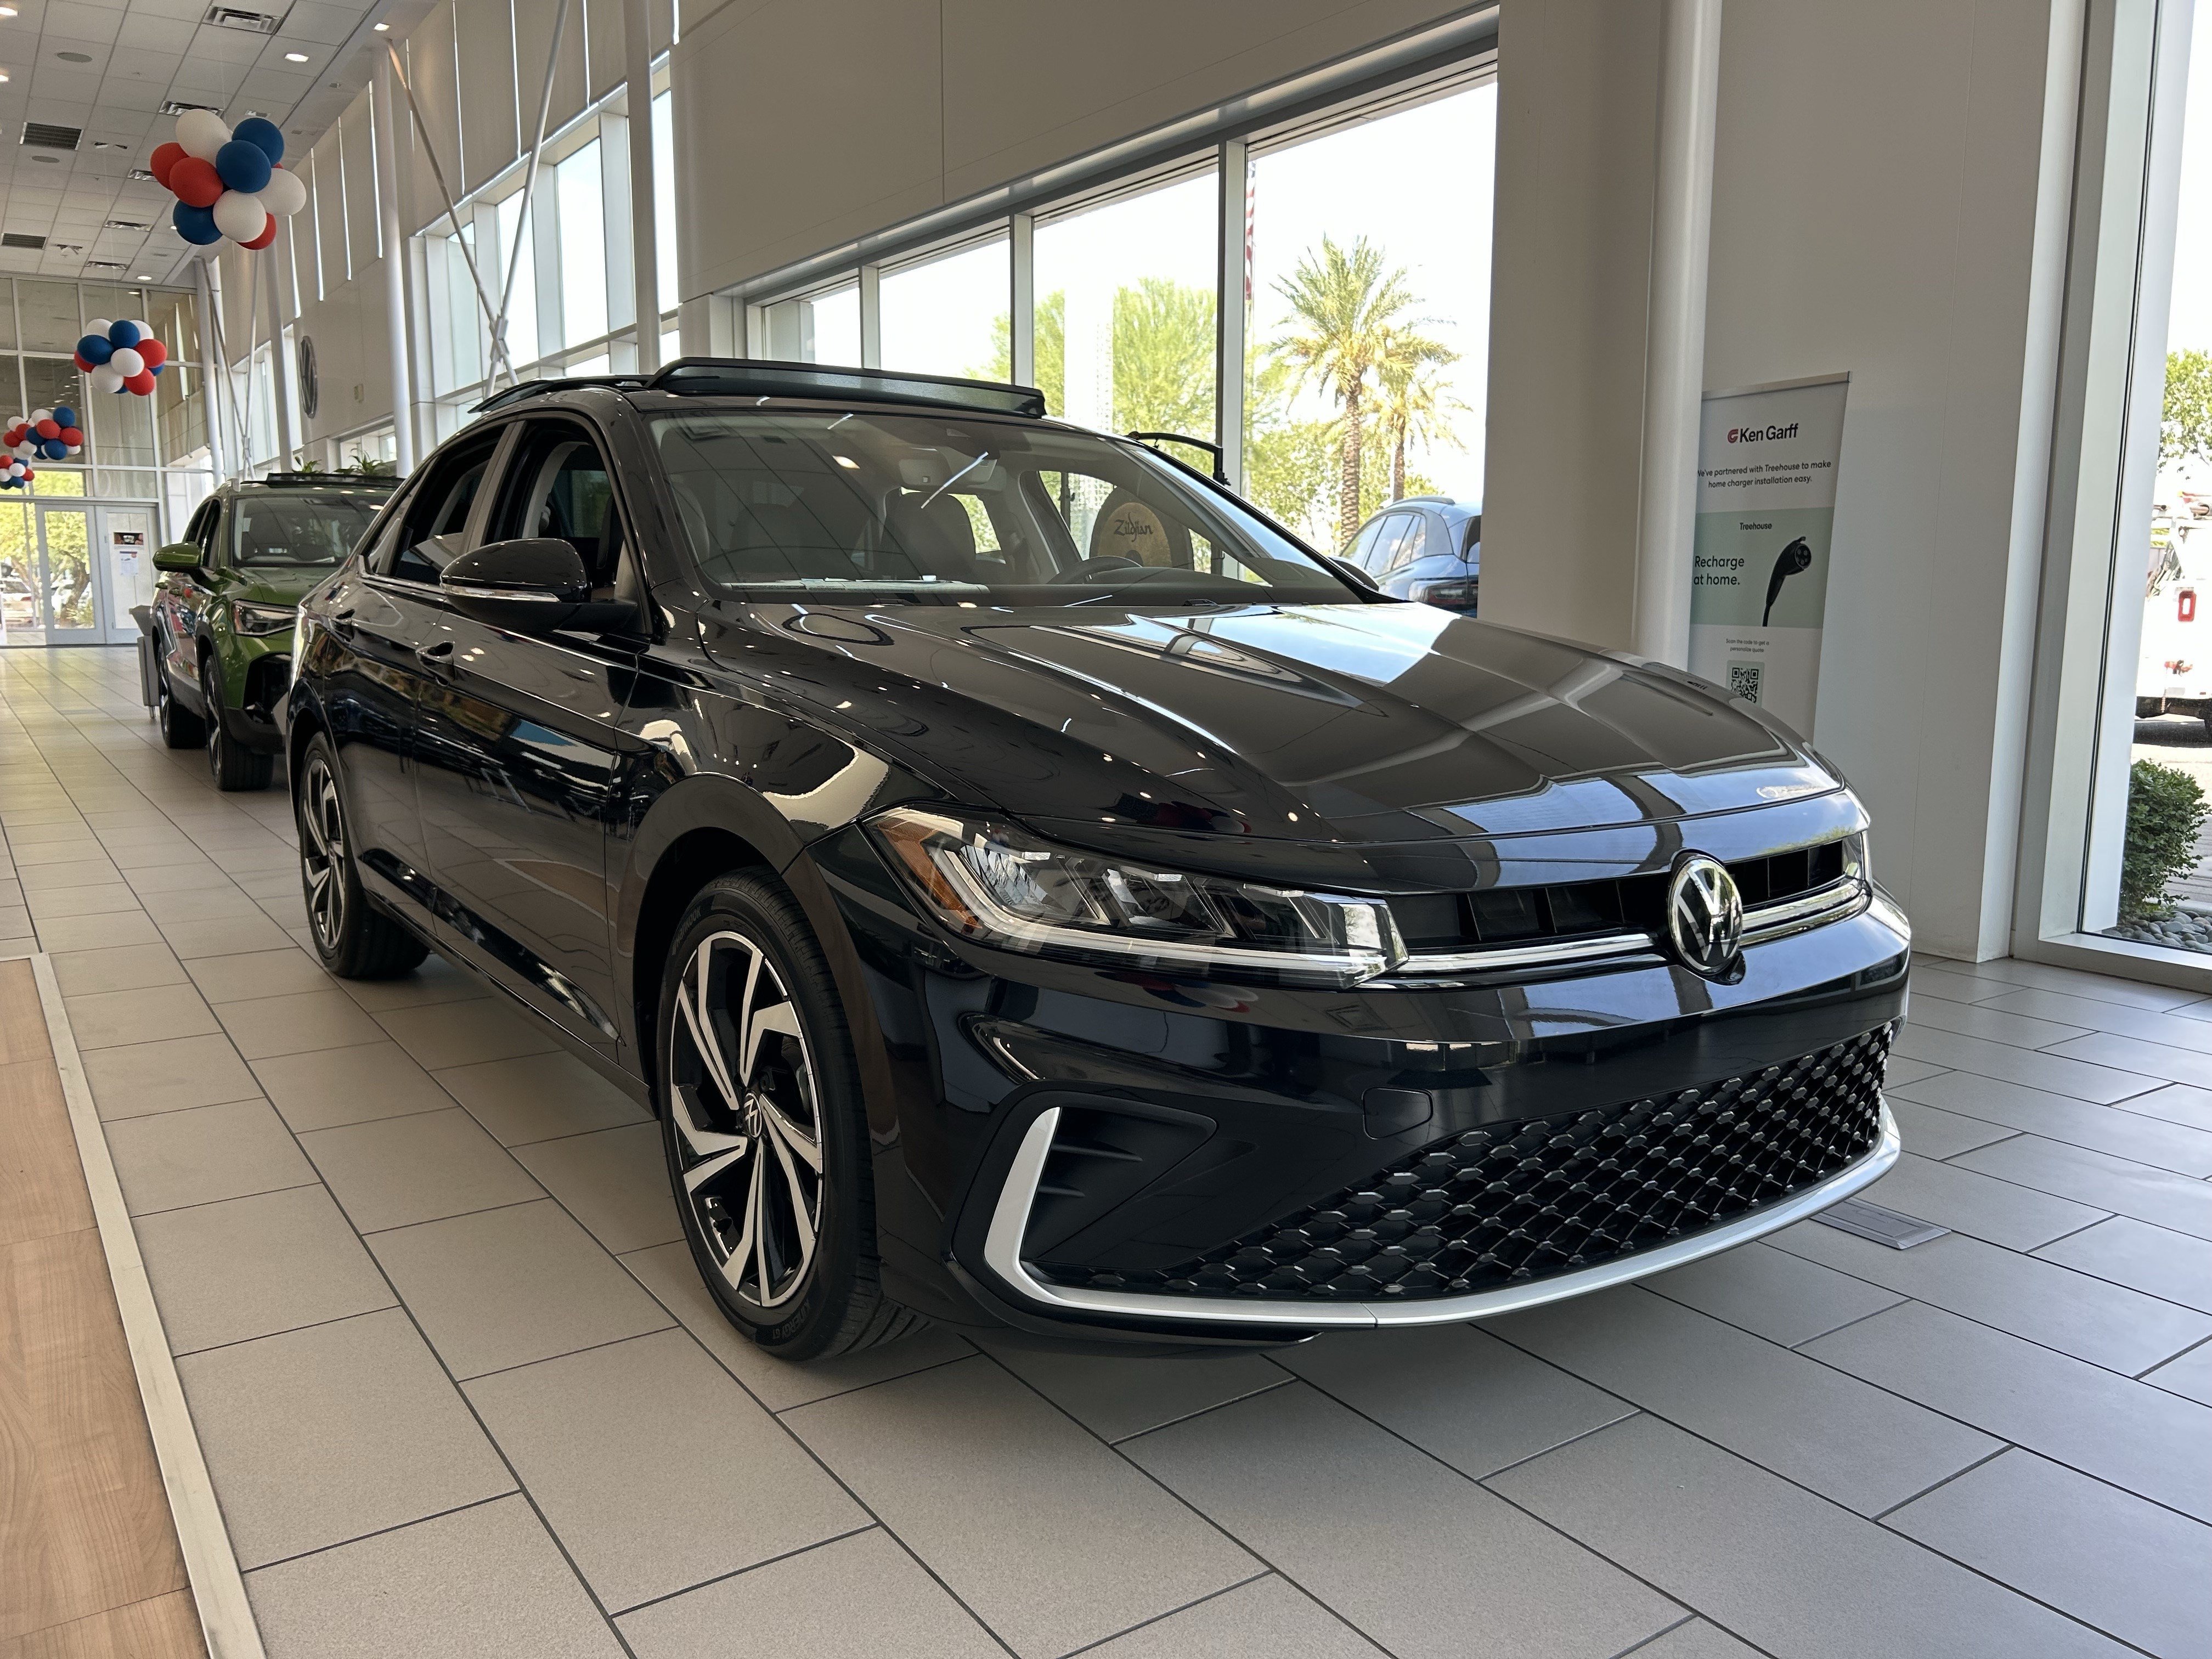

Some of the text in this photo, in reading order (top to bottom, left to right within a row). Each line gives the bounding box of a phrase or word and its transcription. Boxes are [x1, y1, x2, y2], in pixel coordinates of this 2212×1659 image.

[1739, 423, 1799, 443] Ken Garff
[1714, 466, 1748, 477] partnered
[1749, 465, 1763, 473] with
[1765, 464, 1800, 472] Treehouse
[1811, 460, 1831, 469] make
[1727, 479, 1753, 488] charger
[1754, 476, 1793, 485] installation
[1794, 476, 1813, 484] easy.
[1114, 512, 1153, 543] Zildjian
[1740, 522, 1773, 531] Treehouse
[1694, 555, 1745, 571] Recharge
[1693, 573, 1741, 585] at home.
